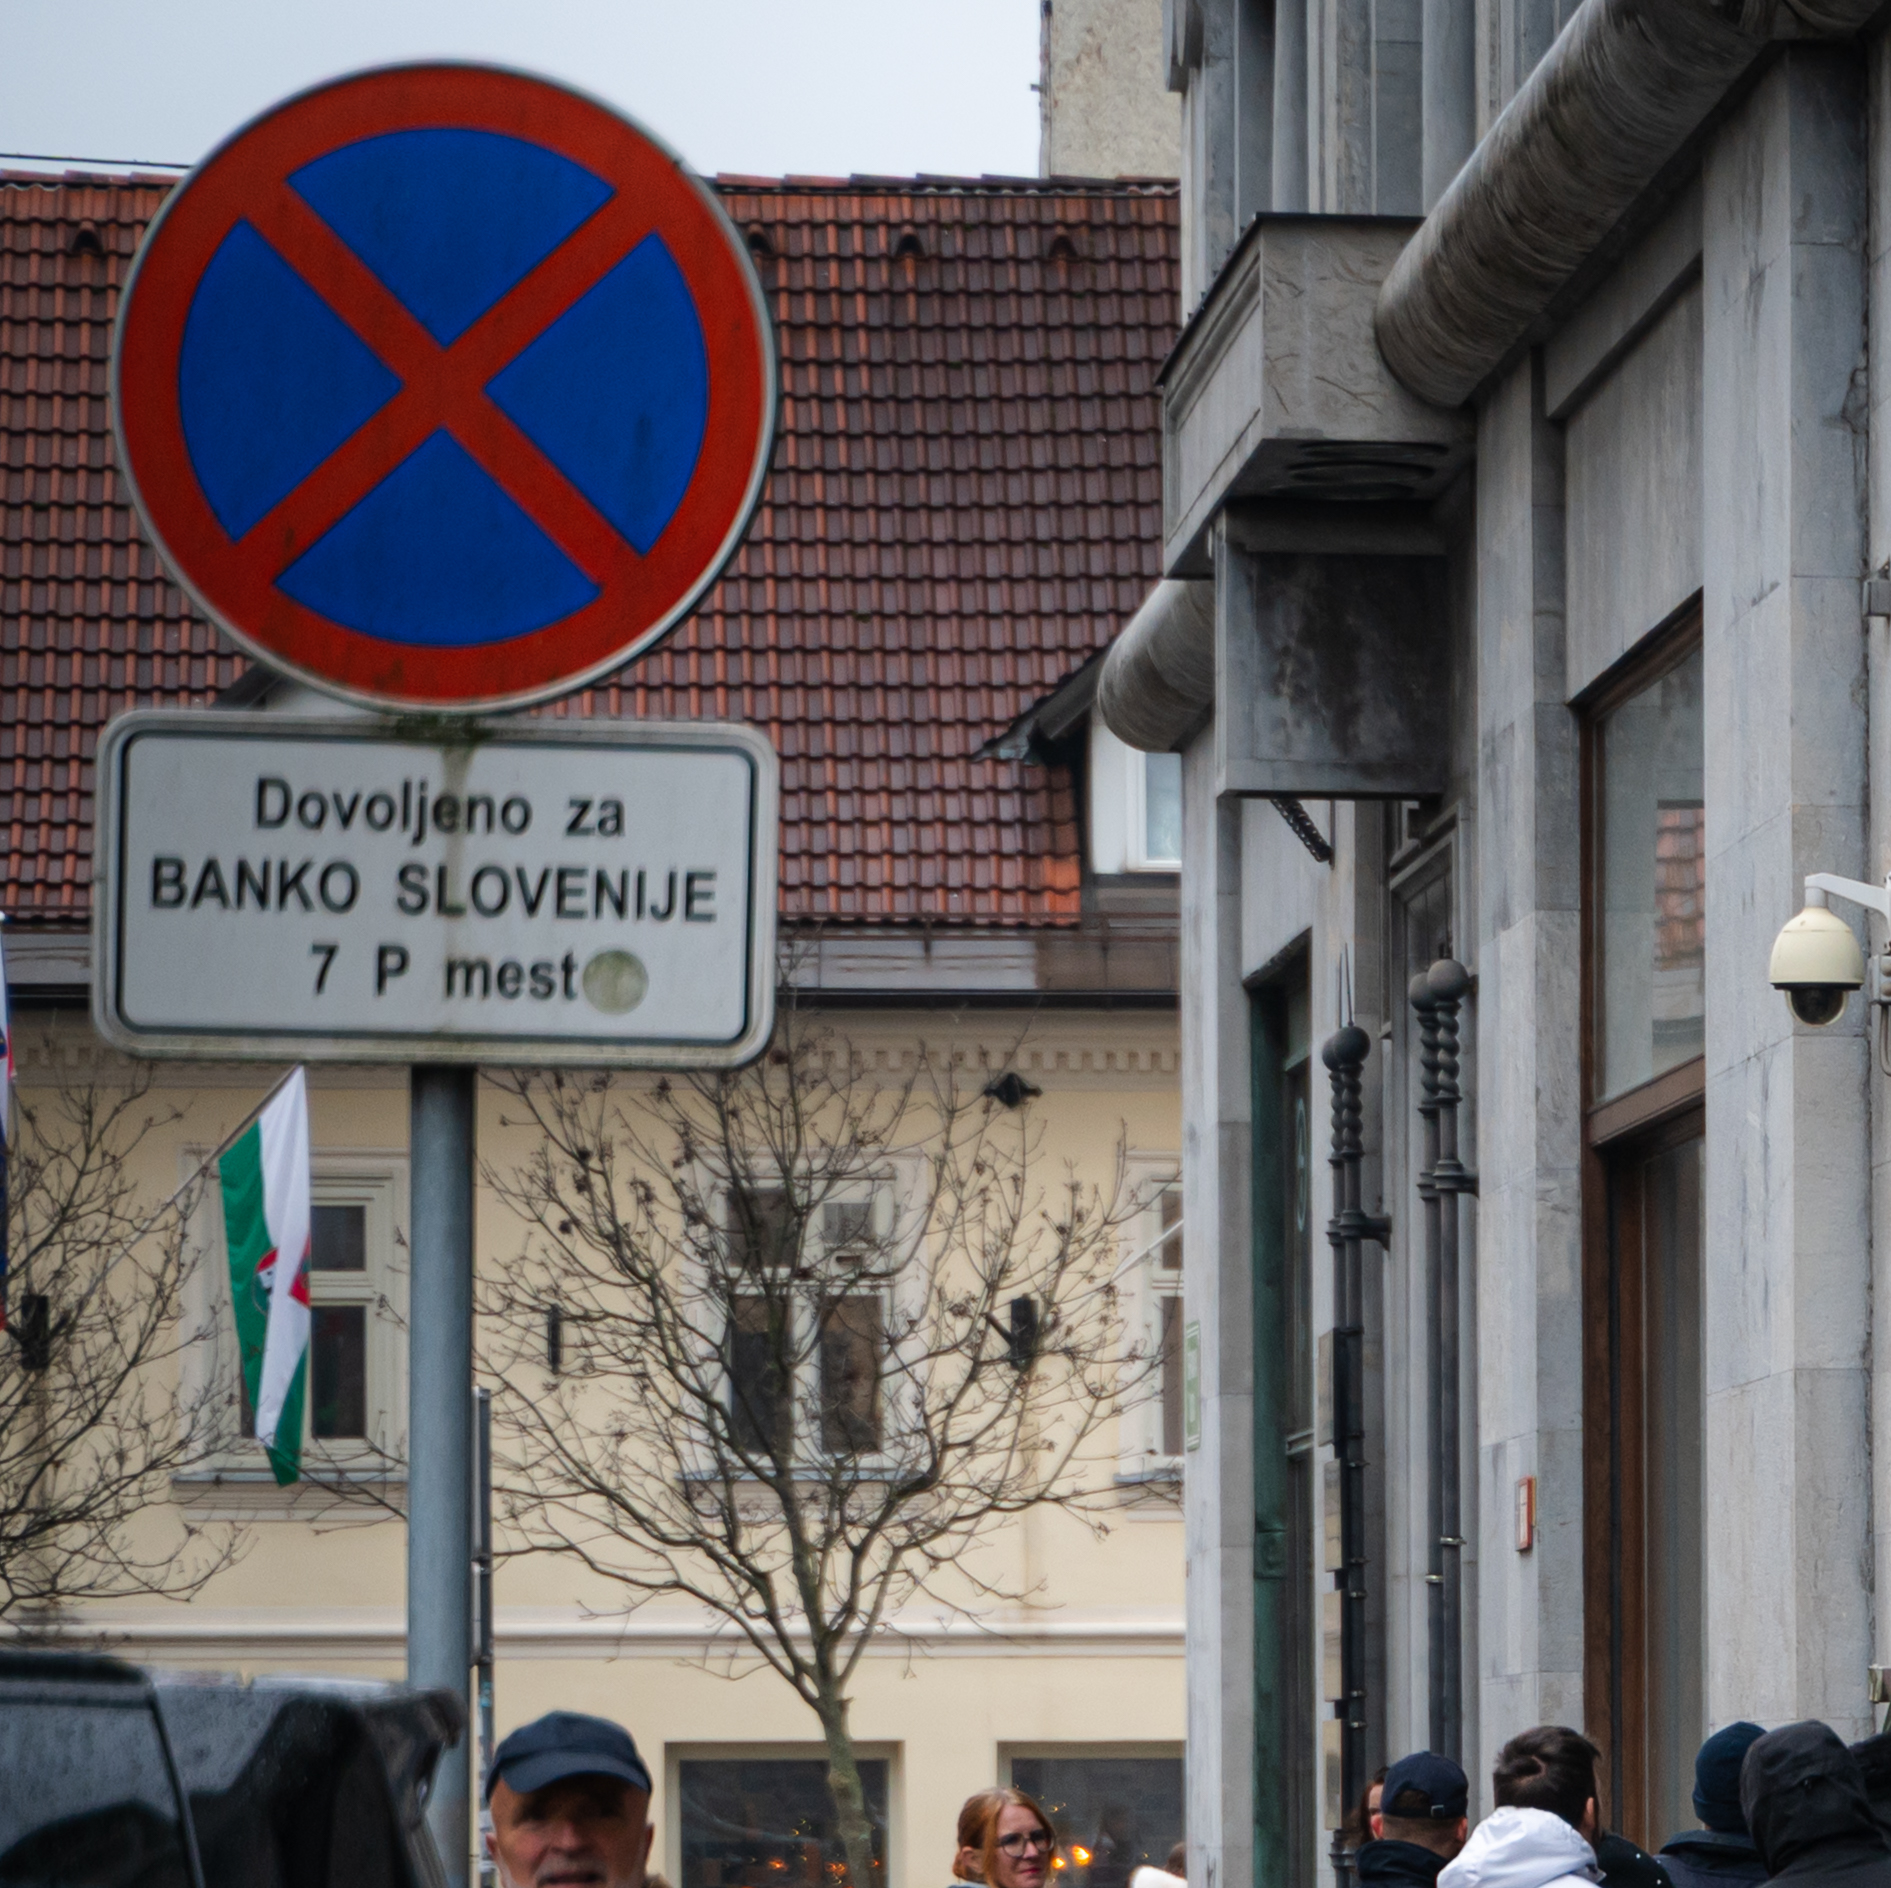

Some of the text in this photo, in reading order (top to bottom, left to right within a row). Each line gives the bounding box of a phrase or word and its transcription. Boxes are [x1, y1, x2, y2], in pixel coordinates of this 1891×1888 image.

[256, 775, 626, 847] Dovoljeno za
[151, 855, 717, 922] BANKO SLOVENIJE
[311, 943, 578, 1001] 7 P mest
